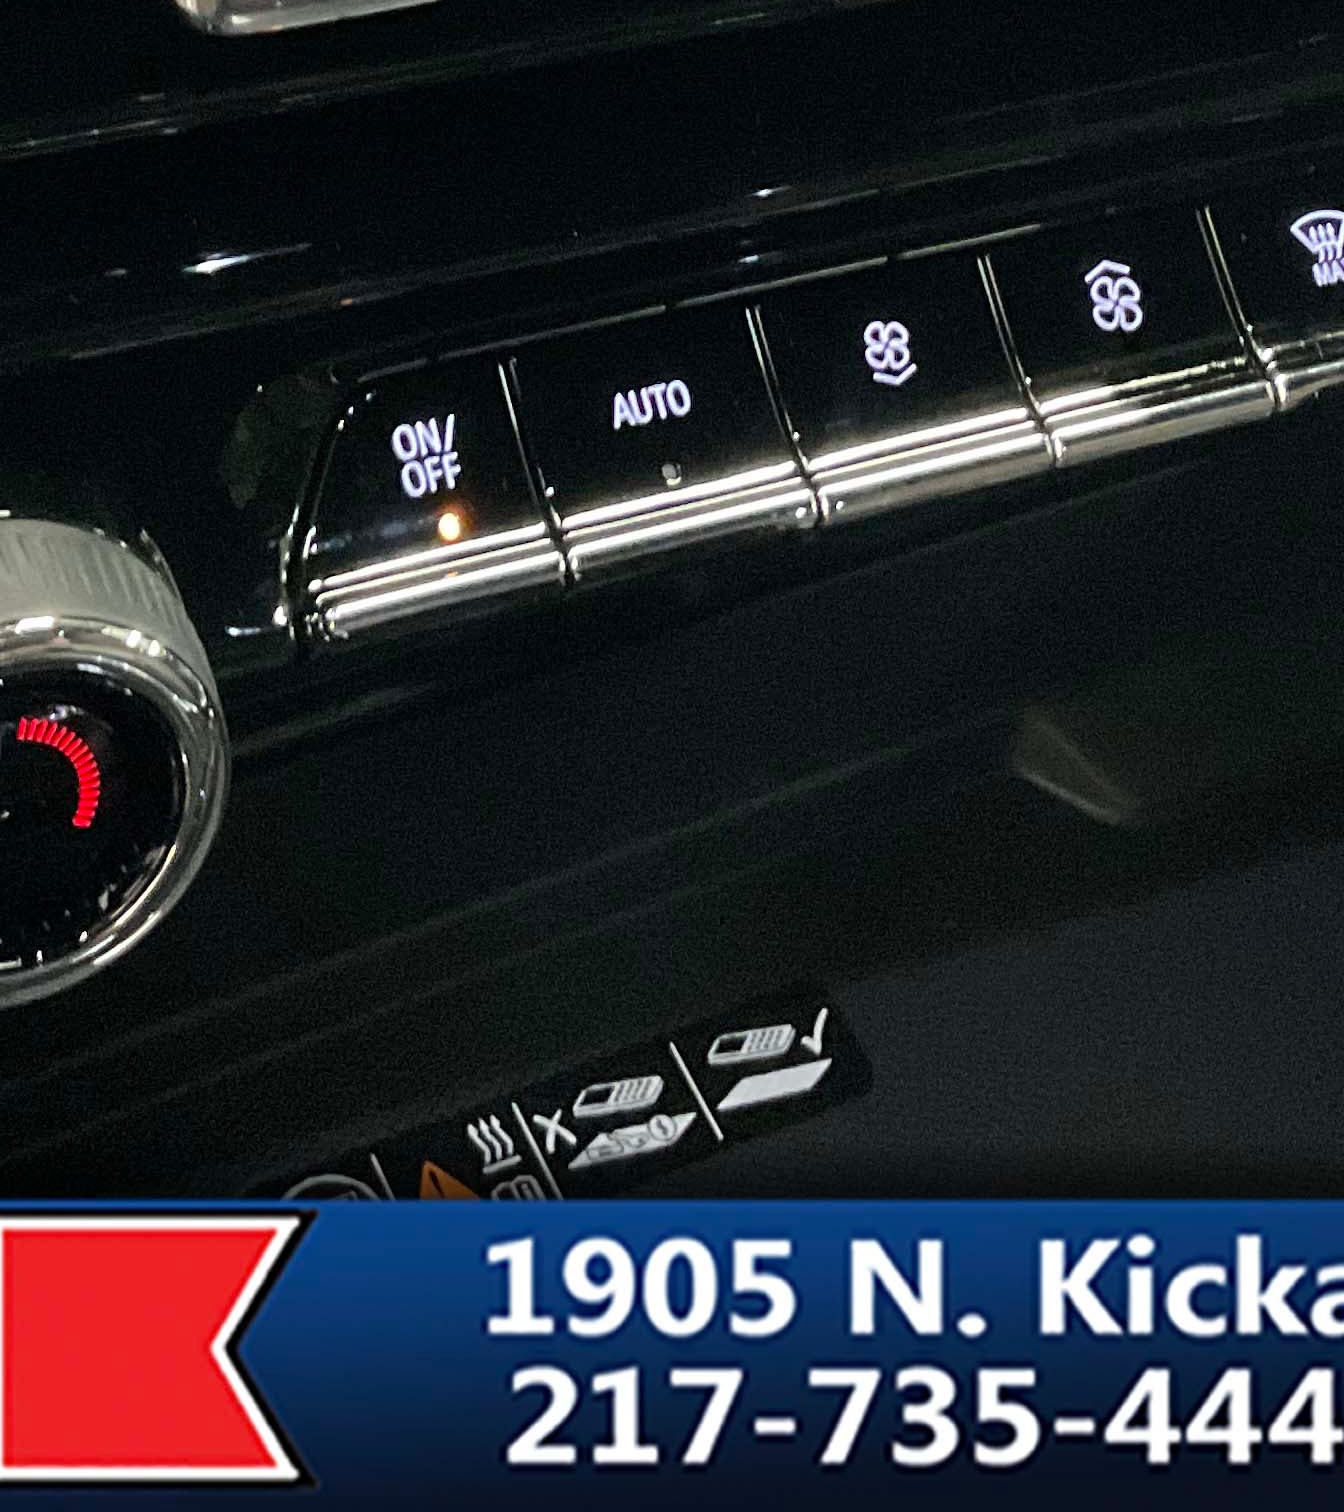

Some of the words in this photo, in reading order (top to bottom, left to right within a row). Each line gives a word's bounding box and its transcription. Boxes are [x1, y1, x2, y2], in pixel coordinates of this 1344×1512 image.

[613, 378, 692, 430] AUTO
[391, 412, 457, 462] ON/
[399, 451, 462, 499] OFF
